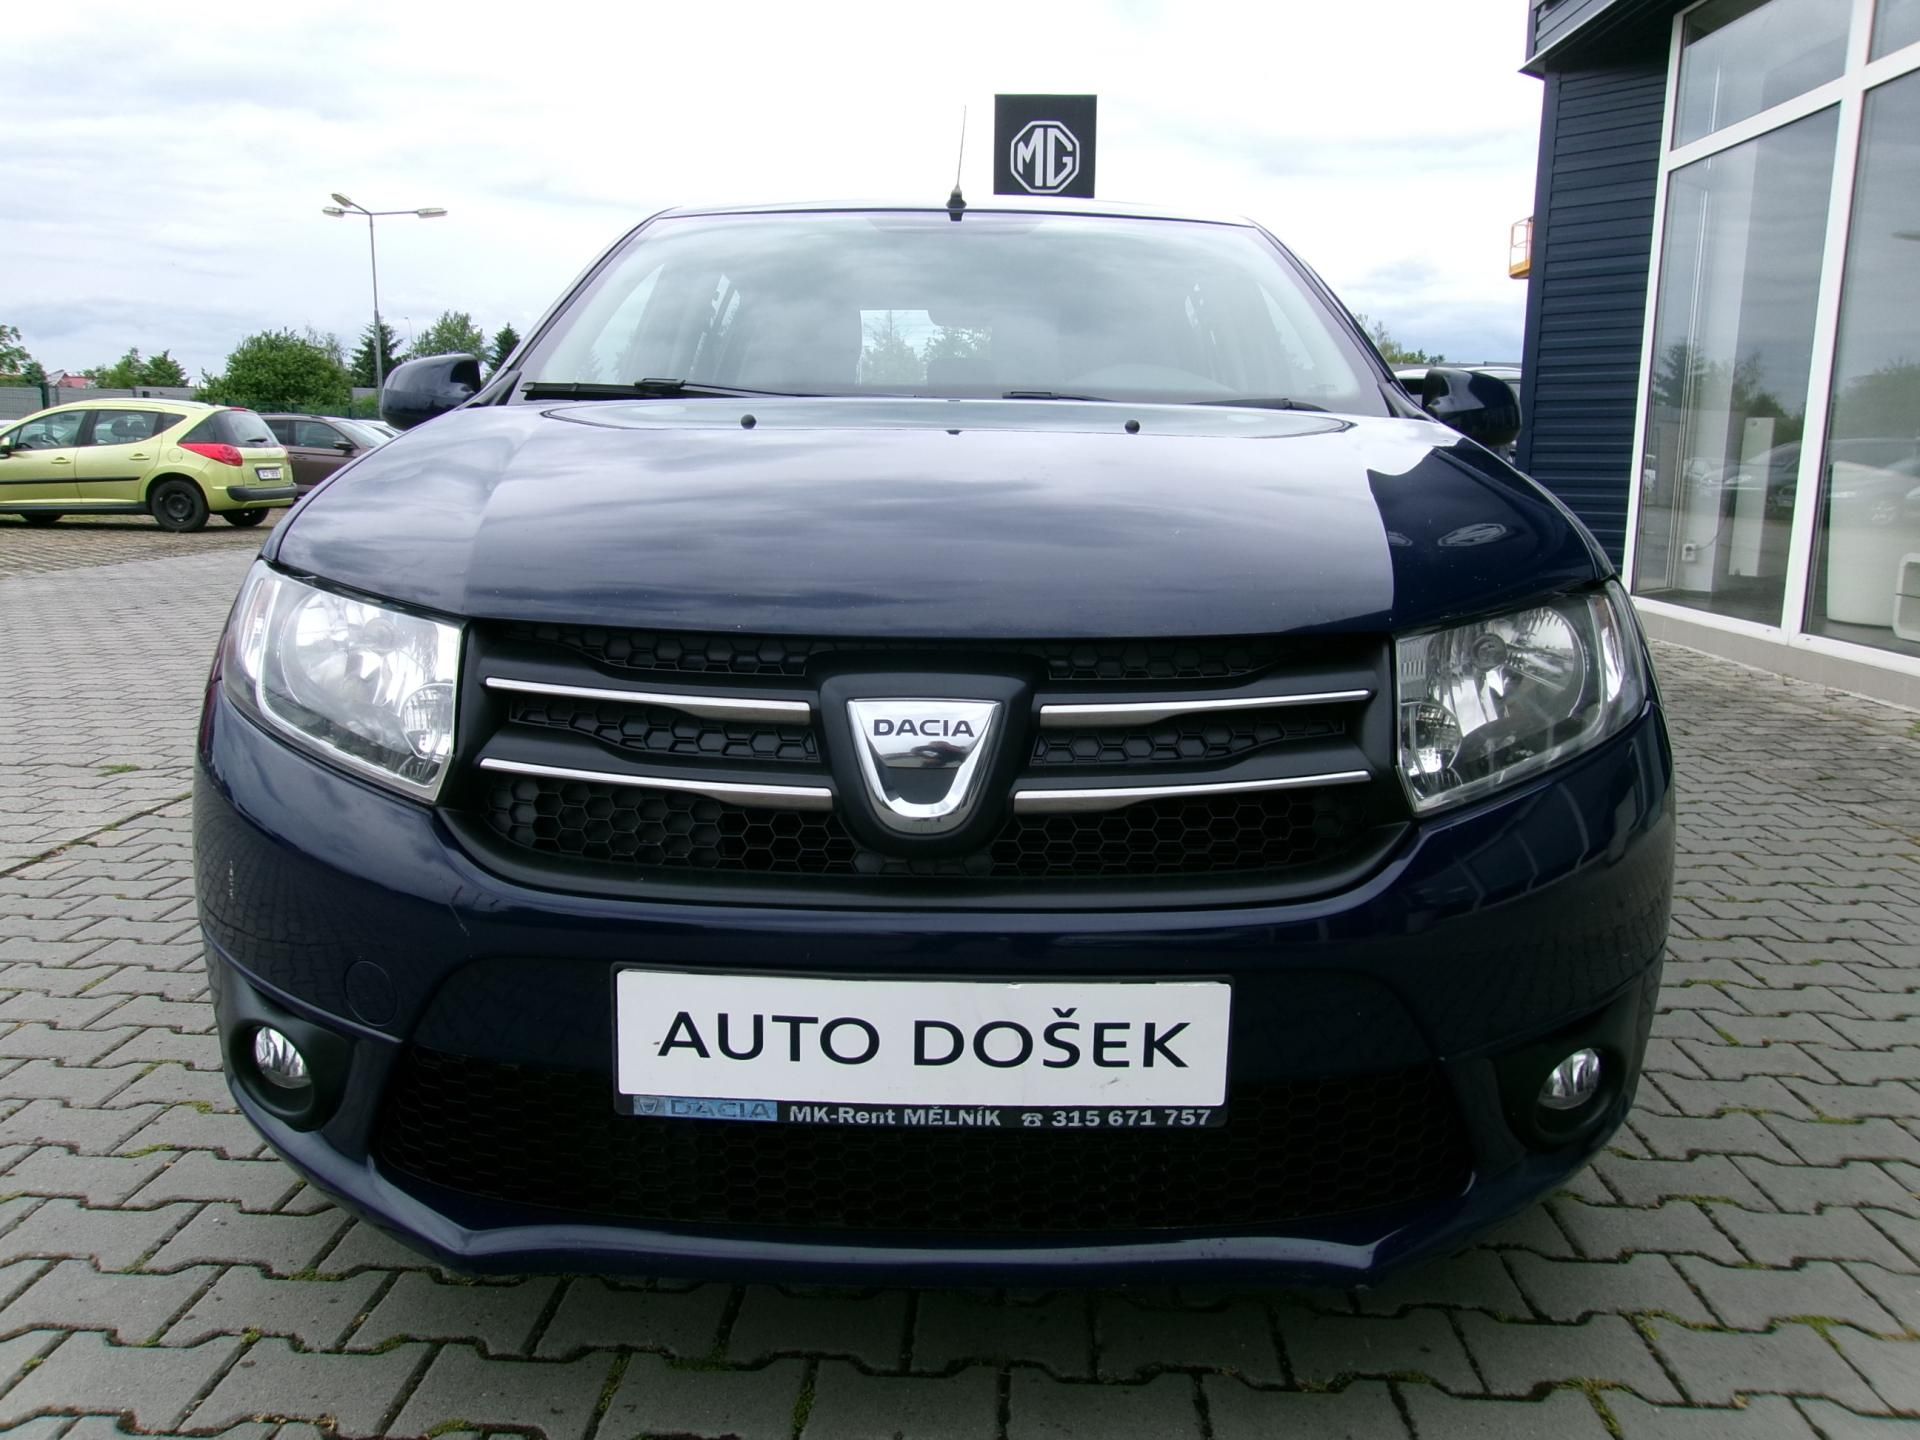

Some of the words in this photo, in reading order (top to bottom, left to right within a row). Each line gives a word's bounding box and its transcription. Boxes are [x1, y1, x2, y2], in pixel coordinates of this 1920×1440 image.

[1017, 127, 1073, 187] MG
[873, 719, 975, 737] DACIA
[657, 1011, 880, 1065] AUTO
[913, 1007, 1191, 1068] DOŠEK
[670, 1100, 772, 1119] DACIA
[789, 1105, 896, 1125] MK-Rent
[903, 1106, 1001, 1127] MĚLNÍK
[1051, 1109, 1100, 1127] 315
[1107, 1109, 1156, 1127] 671
[1164, 1109, 1212, 1126] 757
